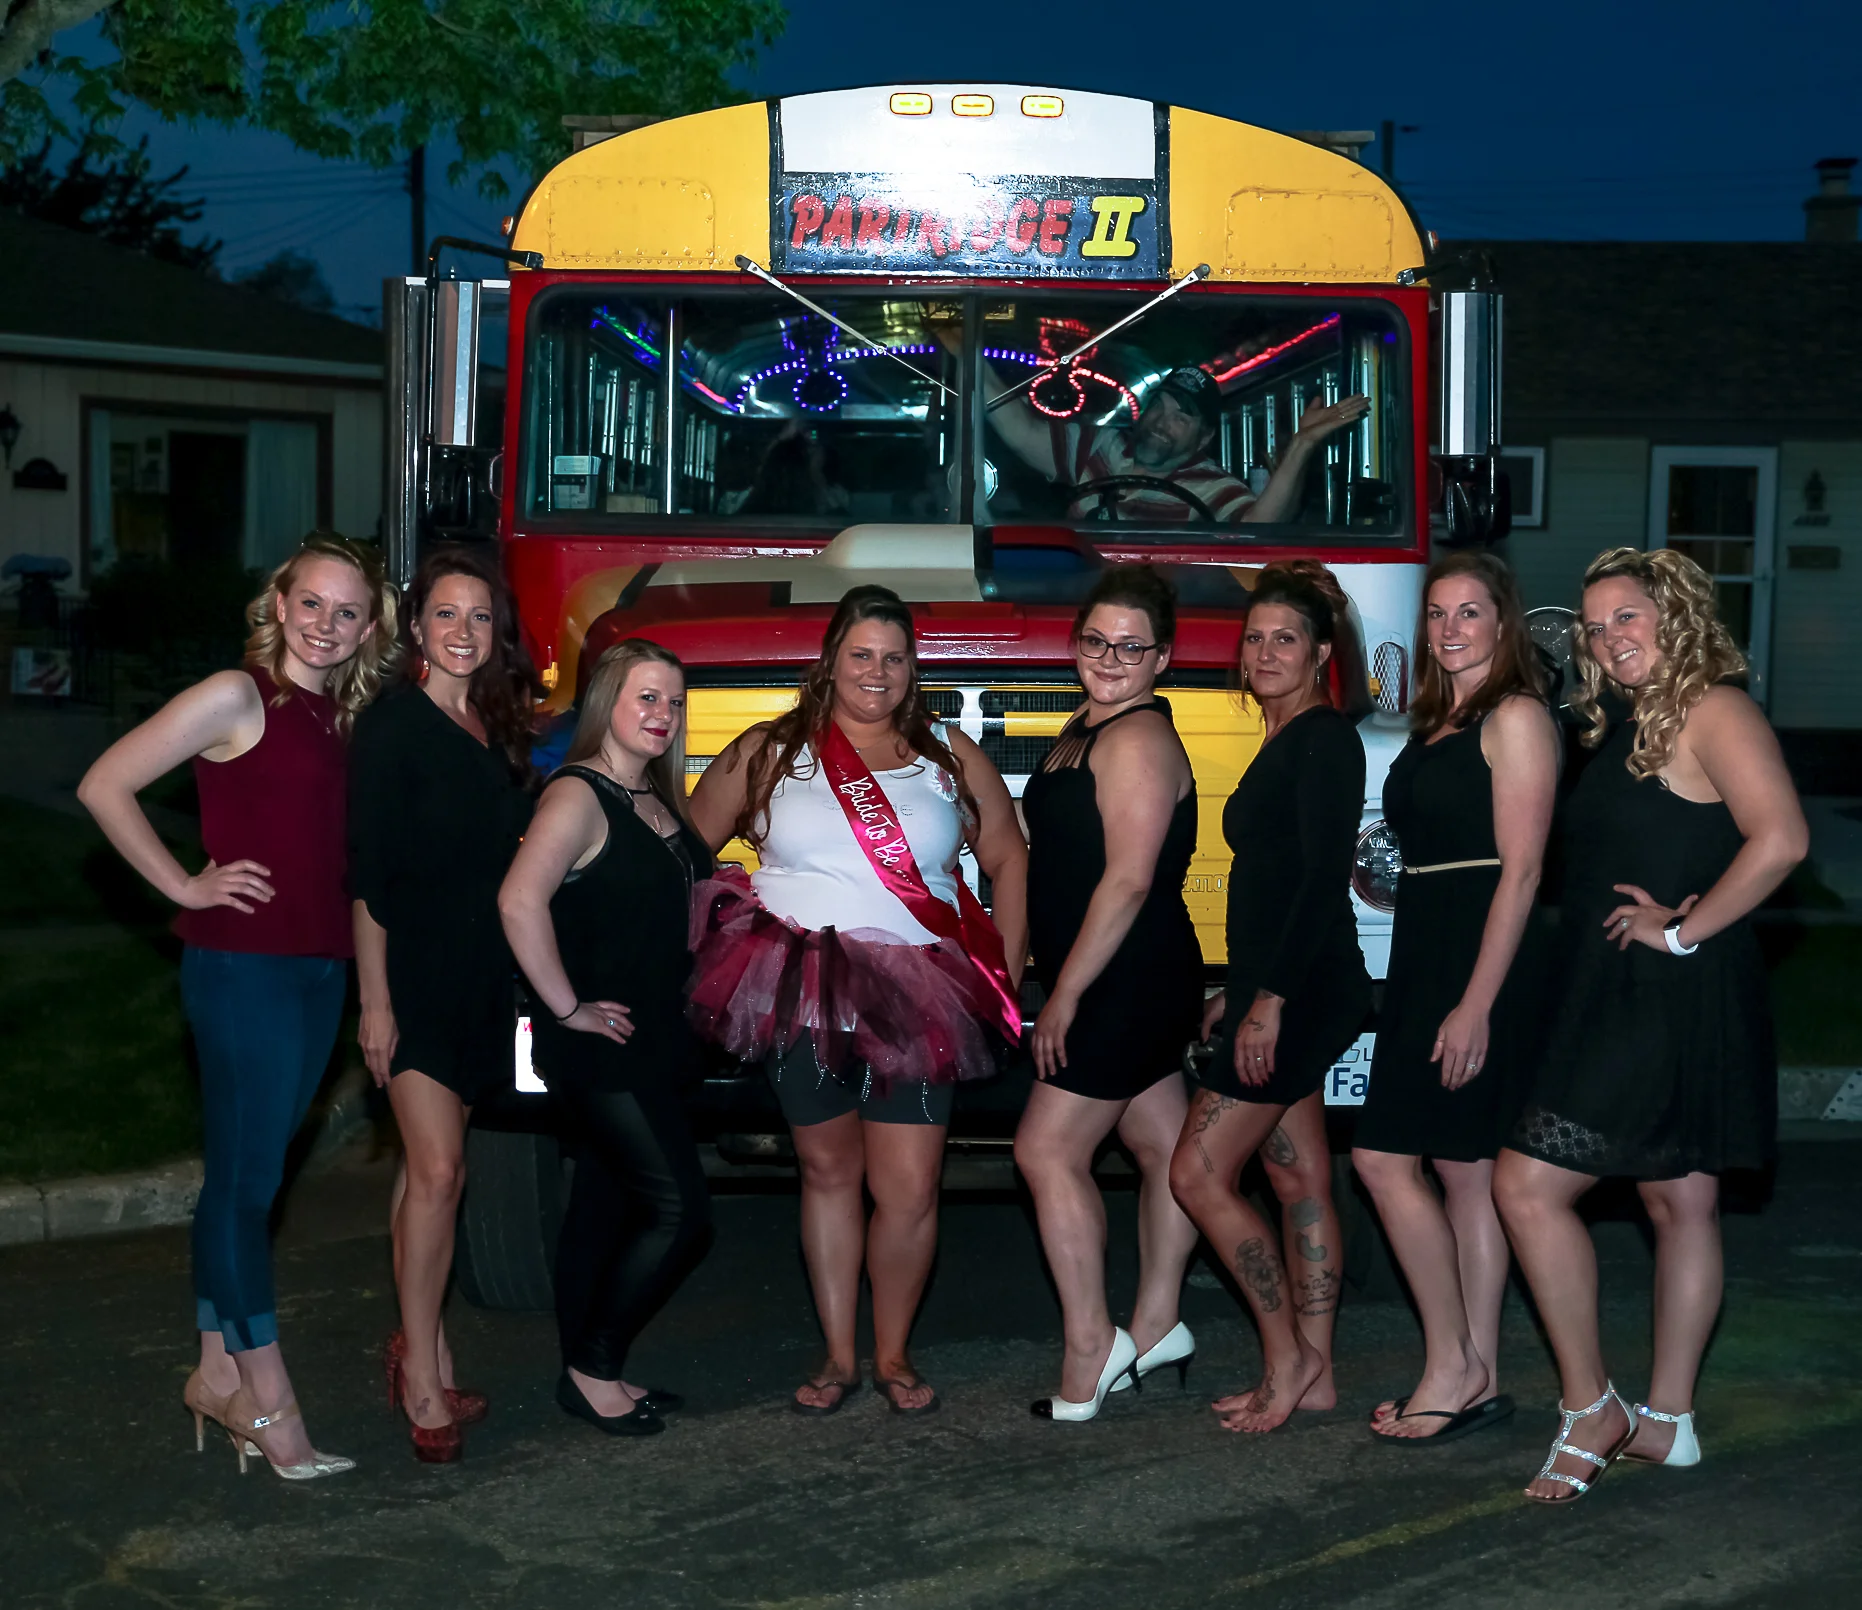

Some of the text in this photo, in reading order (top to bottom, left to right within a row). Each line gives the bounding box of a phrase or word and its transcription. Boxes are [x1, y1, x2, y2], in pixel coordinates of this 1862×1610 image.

[838, 776, 908, 867] Bride To Be
